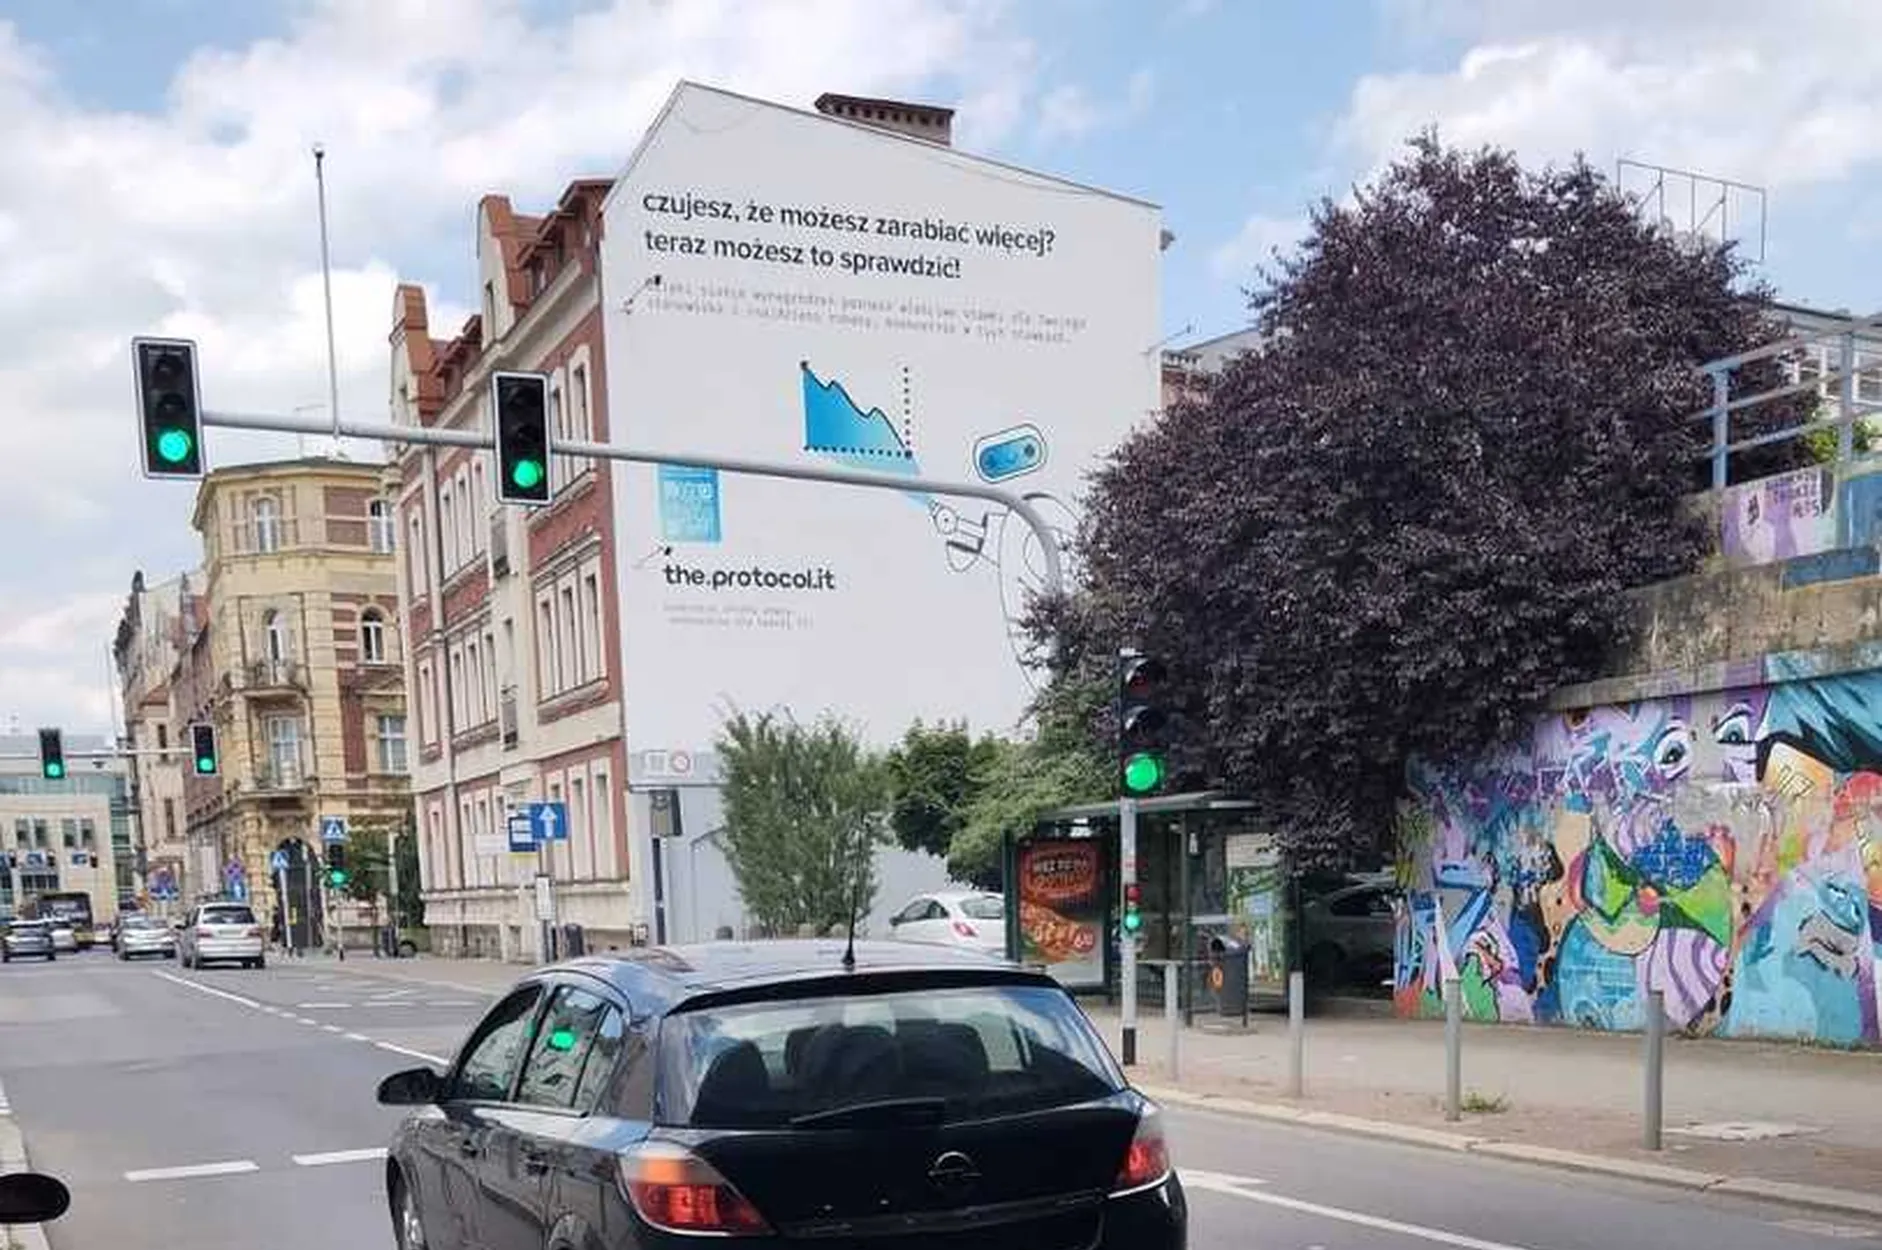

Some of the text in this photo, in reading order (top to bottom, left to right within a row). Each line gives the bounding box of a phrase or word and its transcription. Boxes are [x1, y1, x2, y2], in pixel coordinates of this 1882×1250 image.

[643, 192, 1055, 257] czujesz, że możesz zarabiać więcej?
[645, 230, 706, 255] teraz
[714, 238, 803, 264] możesz
[810, 245, 834, 266] to
[663, 564, 835, 590] the.protocol.it
